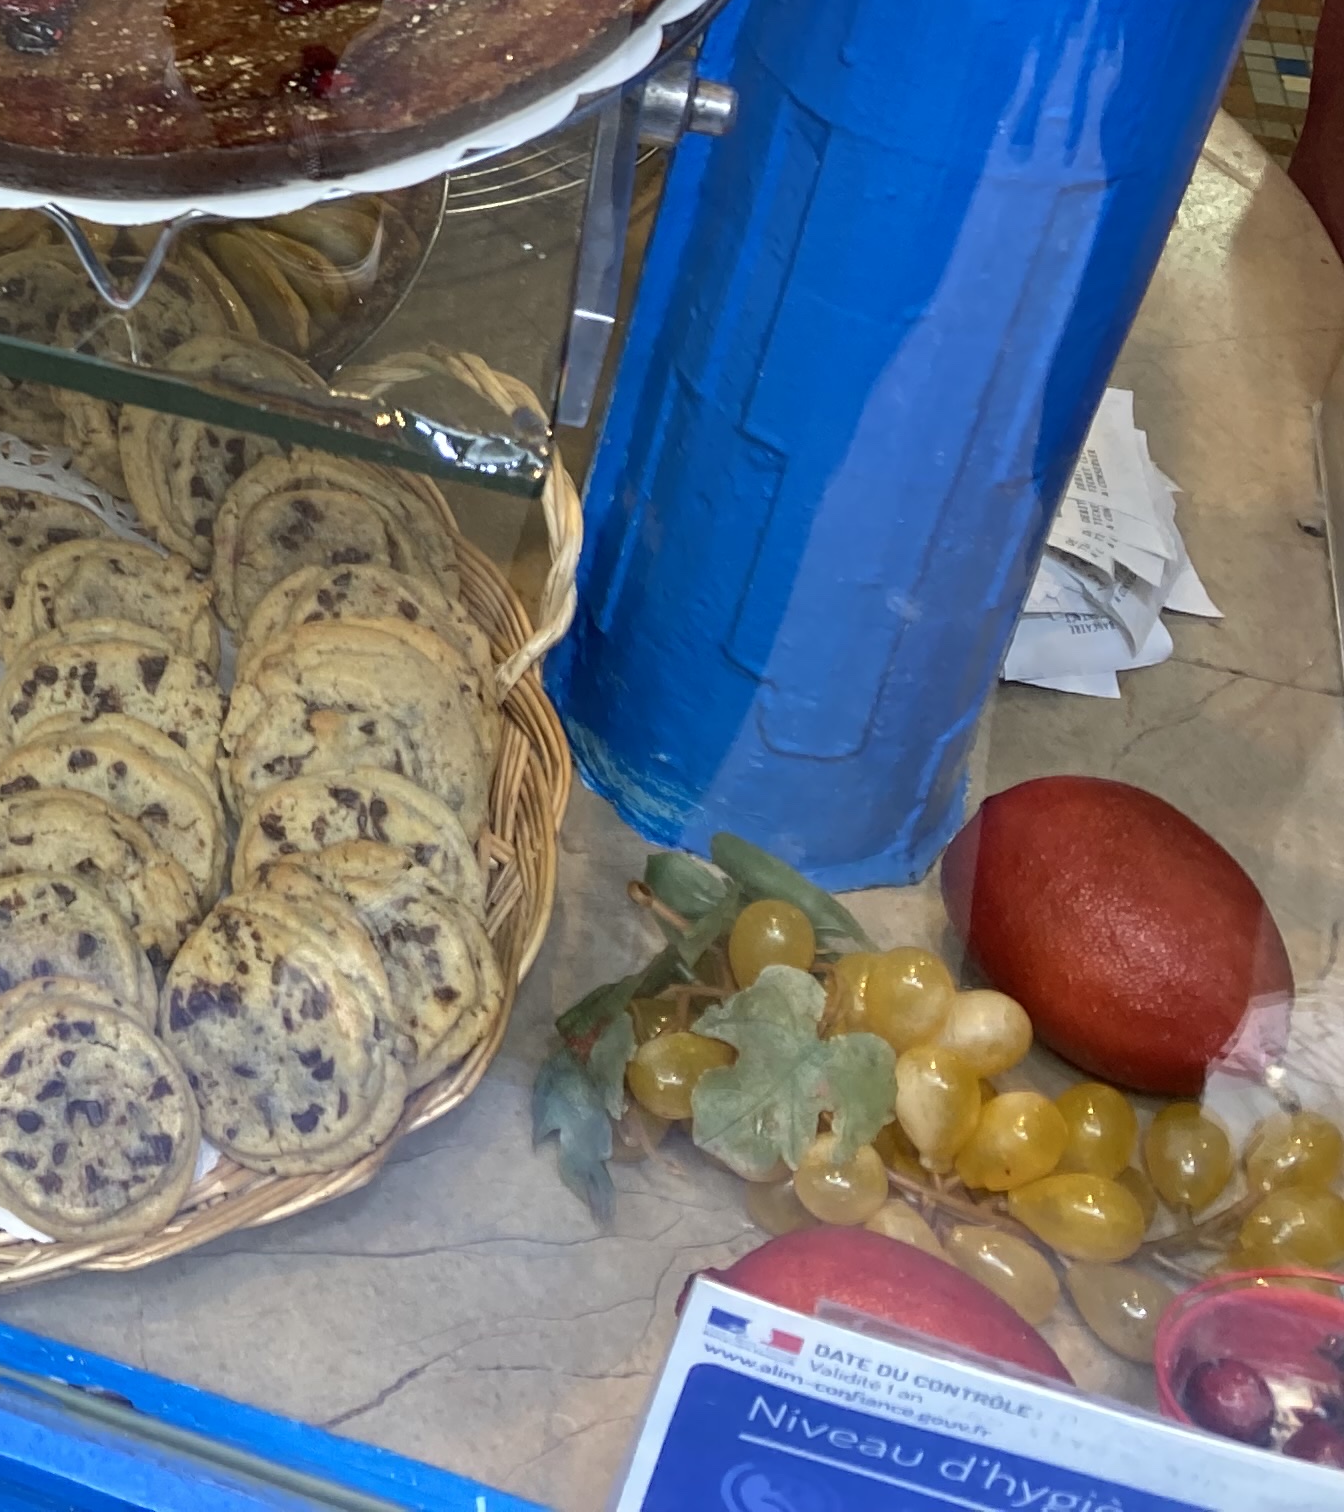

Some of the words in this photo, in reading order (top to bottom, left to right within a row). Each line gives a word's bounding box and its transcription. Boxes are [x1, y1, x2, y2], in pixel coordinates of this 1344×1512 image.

[703, 1342, 993, 1438] www.alim-confiance.gouv.fr
[811, 1359, 883, 1393] Validité
[885, 1382, 895, 1396] 1
[897, 1388, 924, 1405] an
[814, 1343, 870, 1373] DATE
[876, 1362, 910, 1384] DU
[747, 1394, 925, 1468] Niveau
